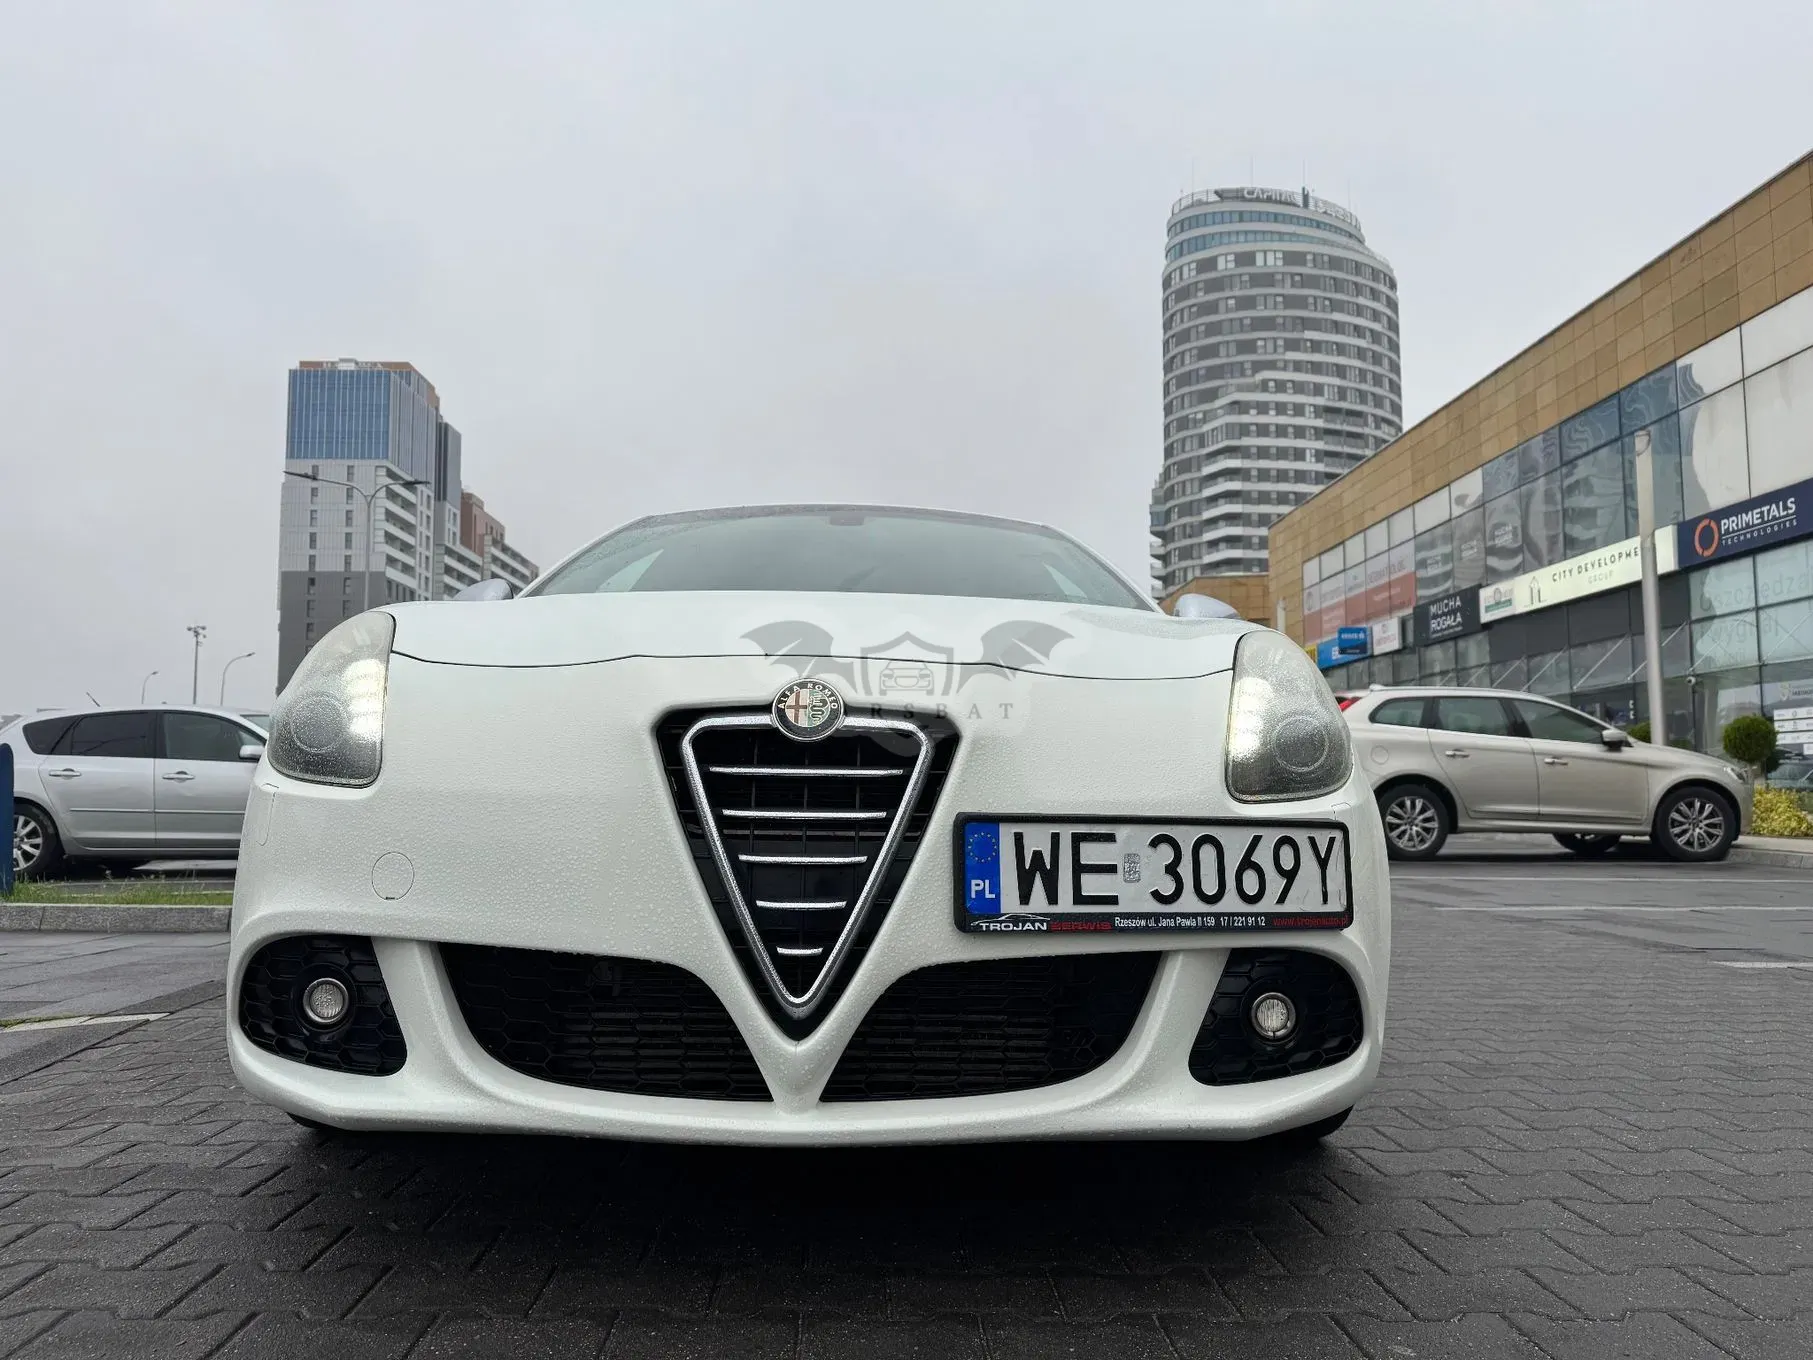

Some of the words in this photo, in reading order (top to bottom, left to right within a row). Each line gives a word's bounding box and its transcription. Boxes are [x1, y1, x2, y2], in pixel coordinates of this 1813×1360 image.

[1720, 497, 1796, 534] PRIMETALS
[1722, 519, 1797, 546] TECHNOLOGIES
[1552, 567, 1574, 582] CITY
[1577, 546, 1640, 575] DEVELOPME
[1430, 595, 1462, 616] MUCHA
[777, 685, 801, 709] ALFA
[807, 683, 838, 709] ROMEO
[970, 879, 996, 899] PL
[979, 922, 1047, 931] TROJAN
[1114, 916, 1146, 927] Rzeszów
[1147, 916, 1157, 927] ul.
[1158, 916, 1176, 927] Jana
[1203, 916, 1216, 927] 159
[1220, 916, 1228, 927] 17
[1233, 916, 1246, 927] 221
[1247, 916, 1256, 927] 91
[1257, 916, 1266, 927] 12
